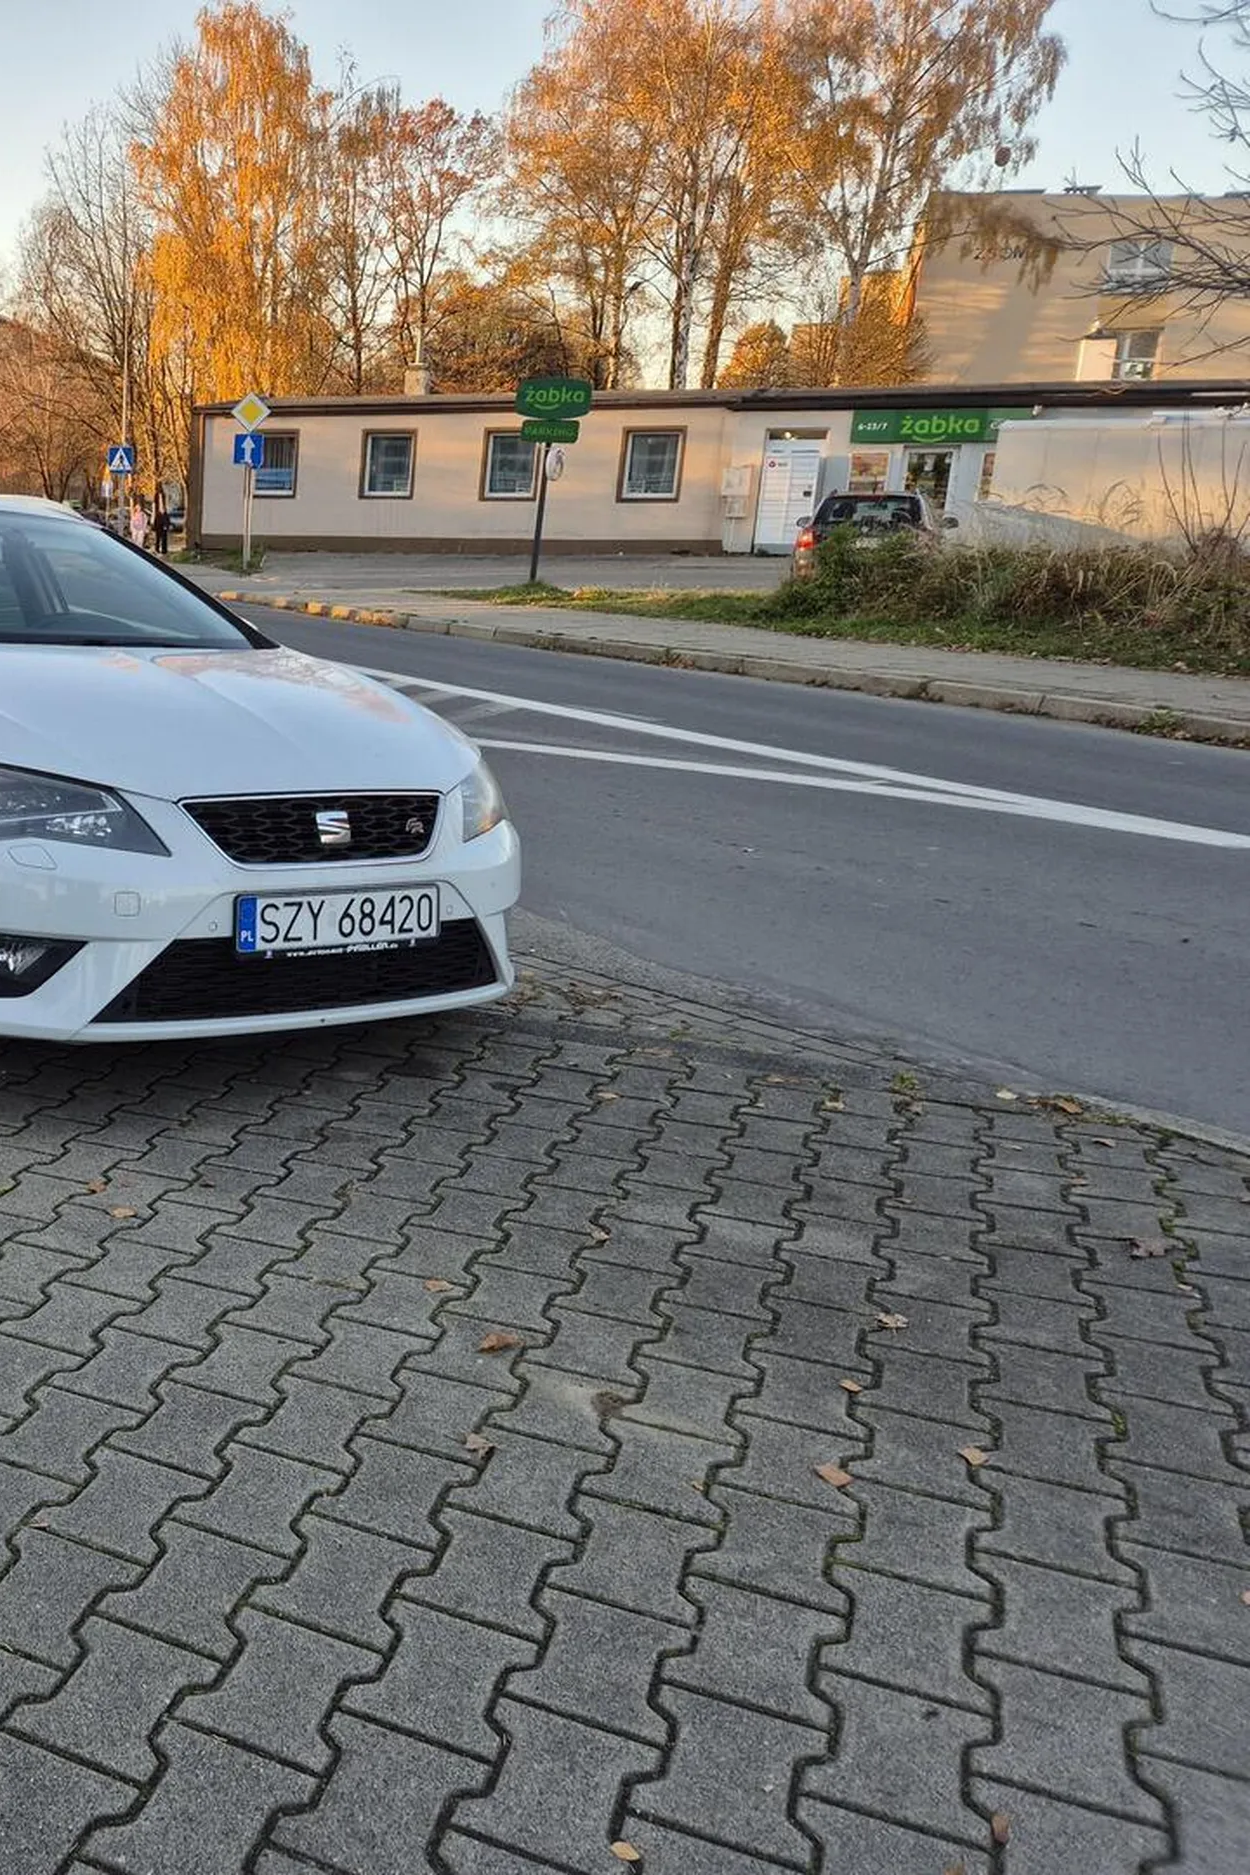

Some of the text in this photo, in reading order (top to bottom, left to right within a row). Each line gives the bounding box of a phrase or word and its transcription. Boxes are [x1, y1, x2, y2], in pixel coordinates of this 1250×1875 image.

[525, 385, 586, 403] żabka
[900, 415, 981, 435] żabka
[260, 894, 433, 943] SZY 68420
[240, 930, 254, 942] PL
